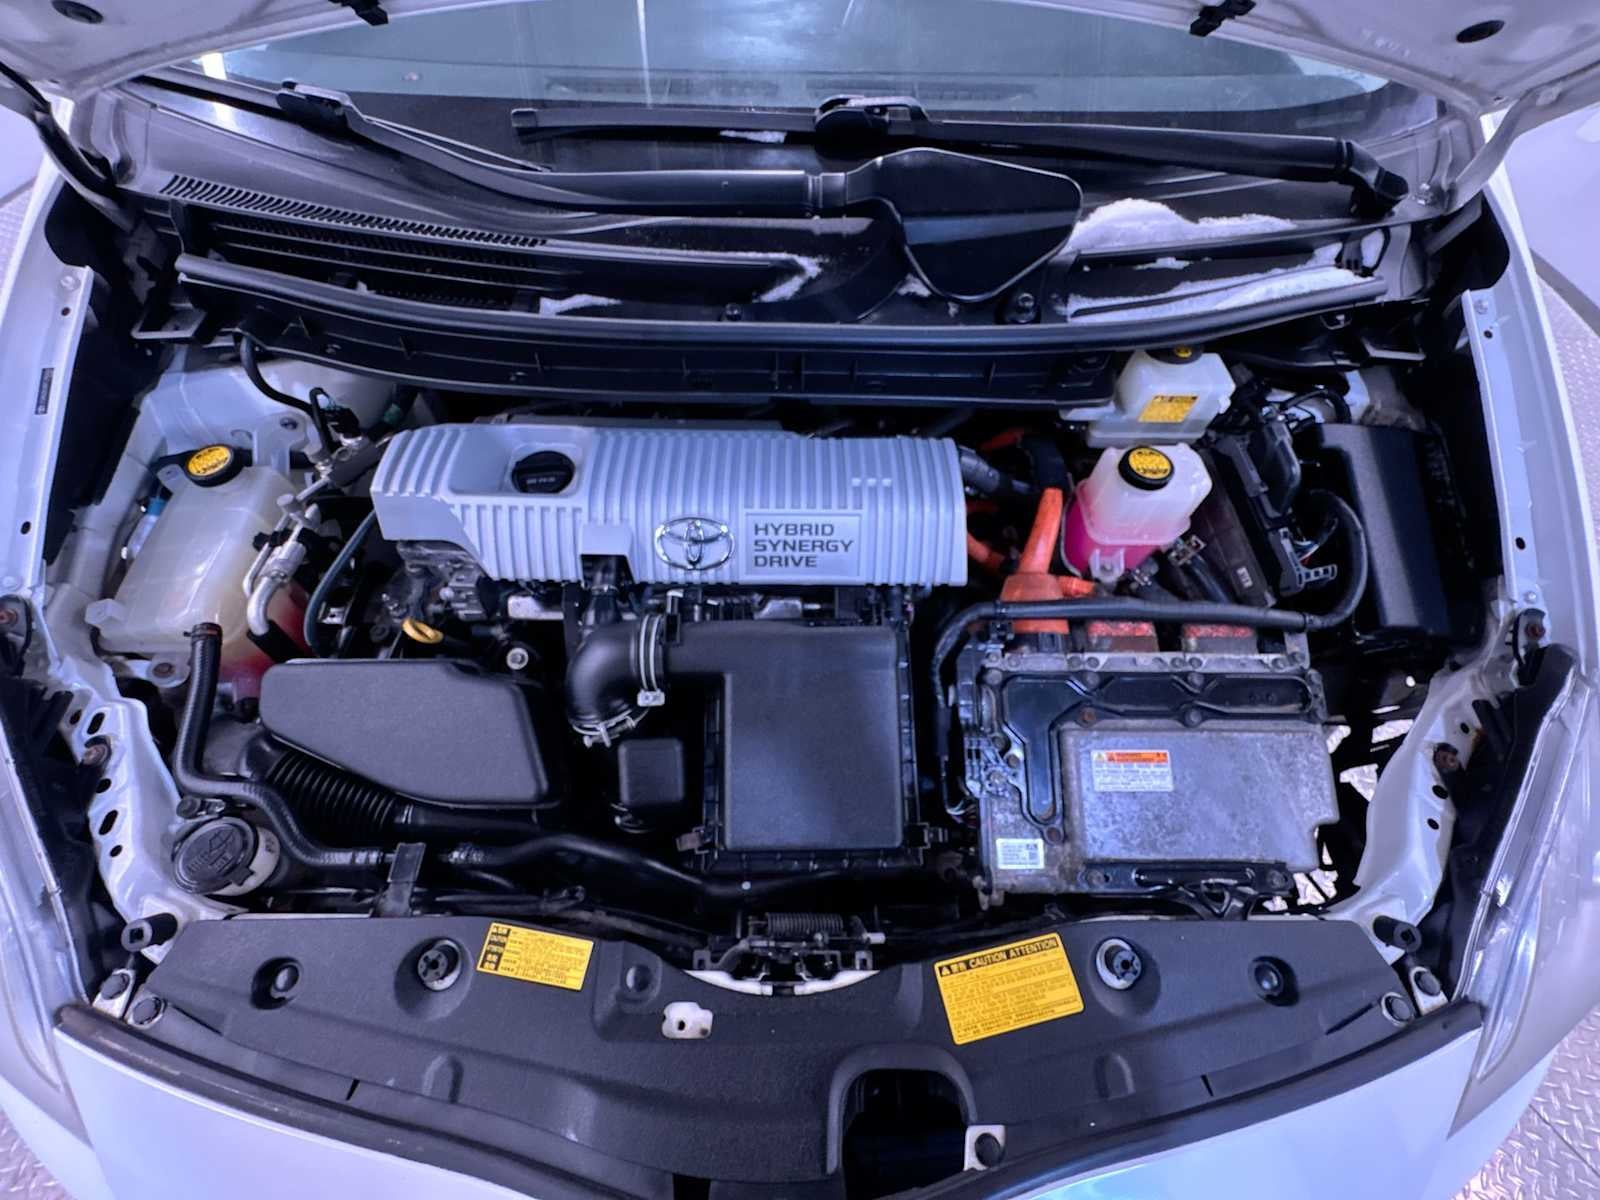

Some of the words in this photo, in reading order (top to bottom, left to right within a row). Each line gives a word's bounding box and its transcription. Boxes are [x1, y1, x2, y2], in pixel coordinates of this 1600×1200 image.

[754, 523, 834, 536] HYBRID
[754, 539, 853, 552] SYNERGY
[754, 555, 817, 568] DRIVE
[969, 951, 1007, 968] CAUTION
[1009, 939, 1057, 959] ATTENTION
